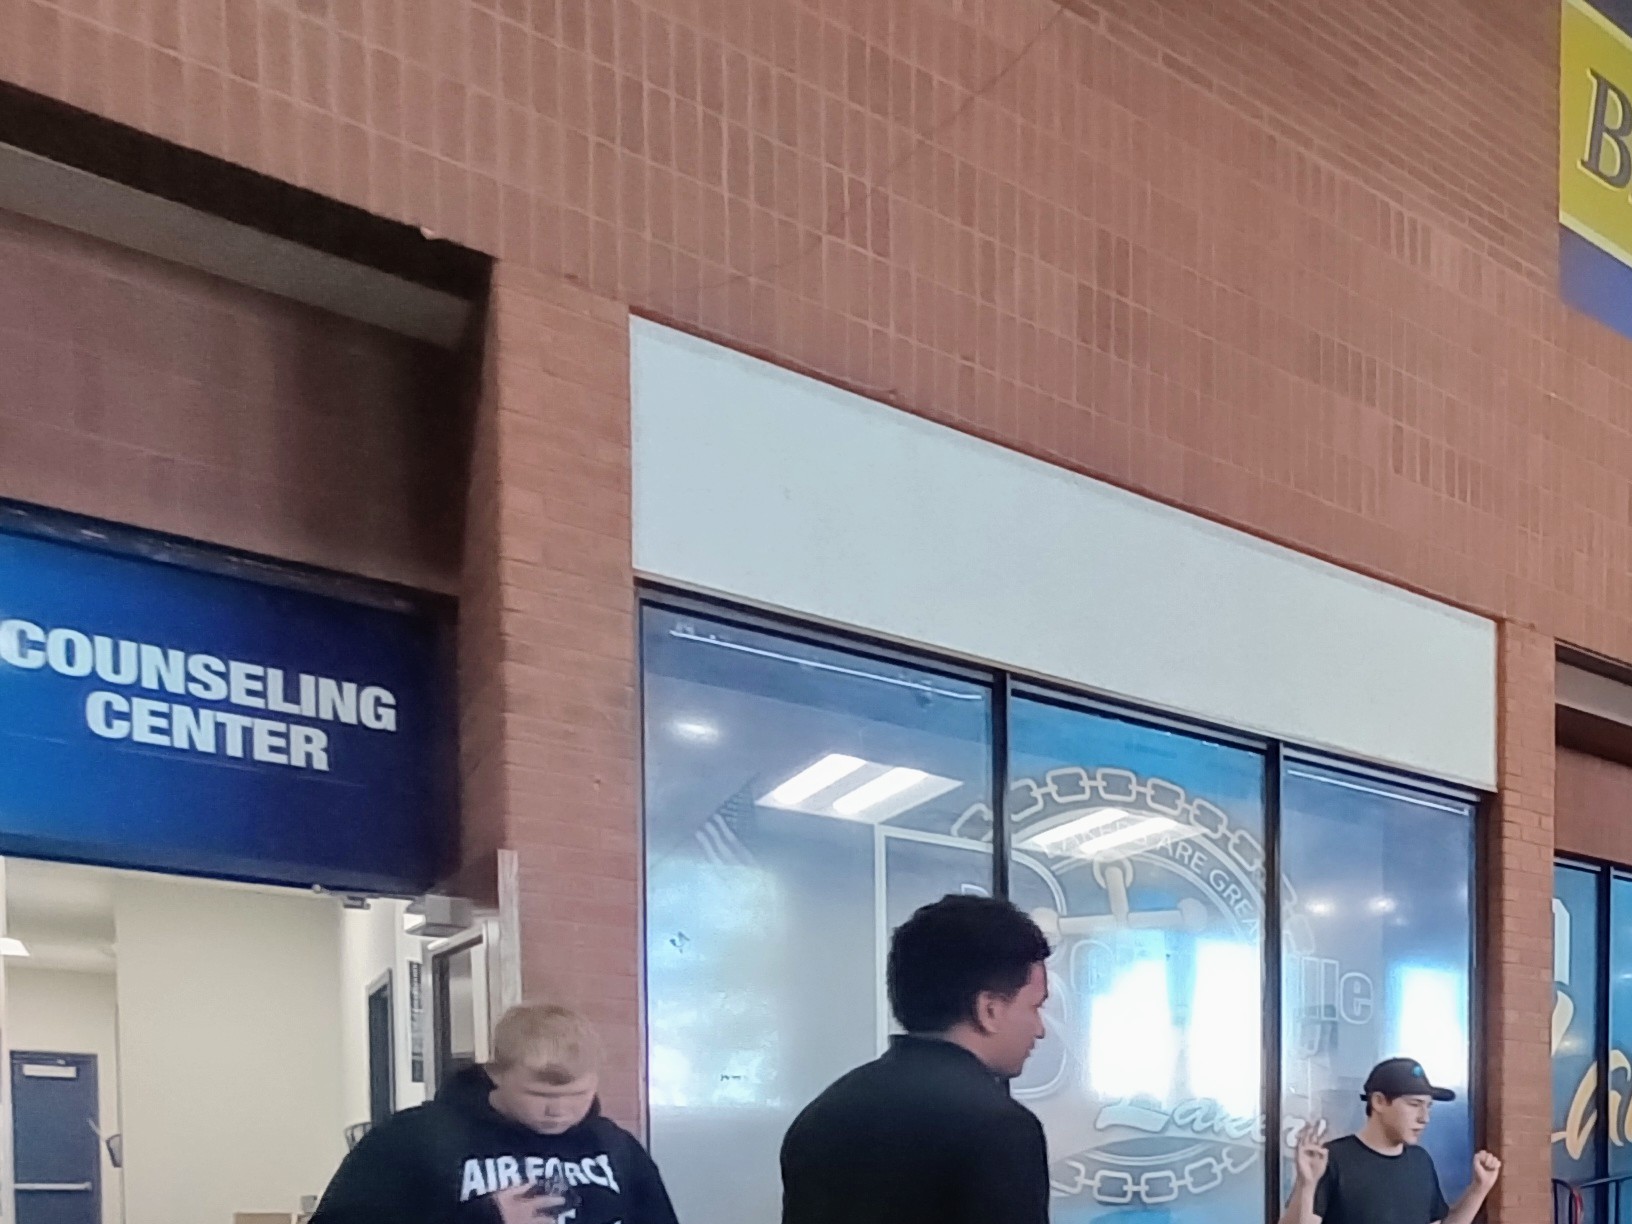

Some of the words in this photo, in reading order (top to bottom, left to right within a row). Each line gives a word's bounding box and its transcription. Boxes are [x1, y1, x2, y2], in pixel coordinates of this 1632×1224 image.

[0, 619, 397, 733] COUNSELING
[84, 690, 330, 772] CENTER
[460, 1155, 522, 1202] AIR
